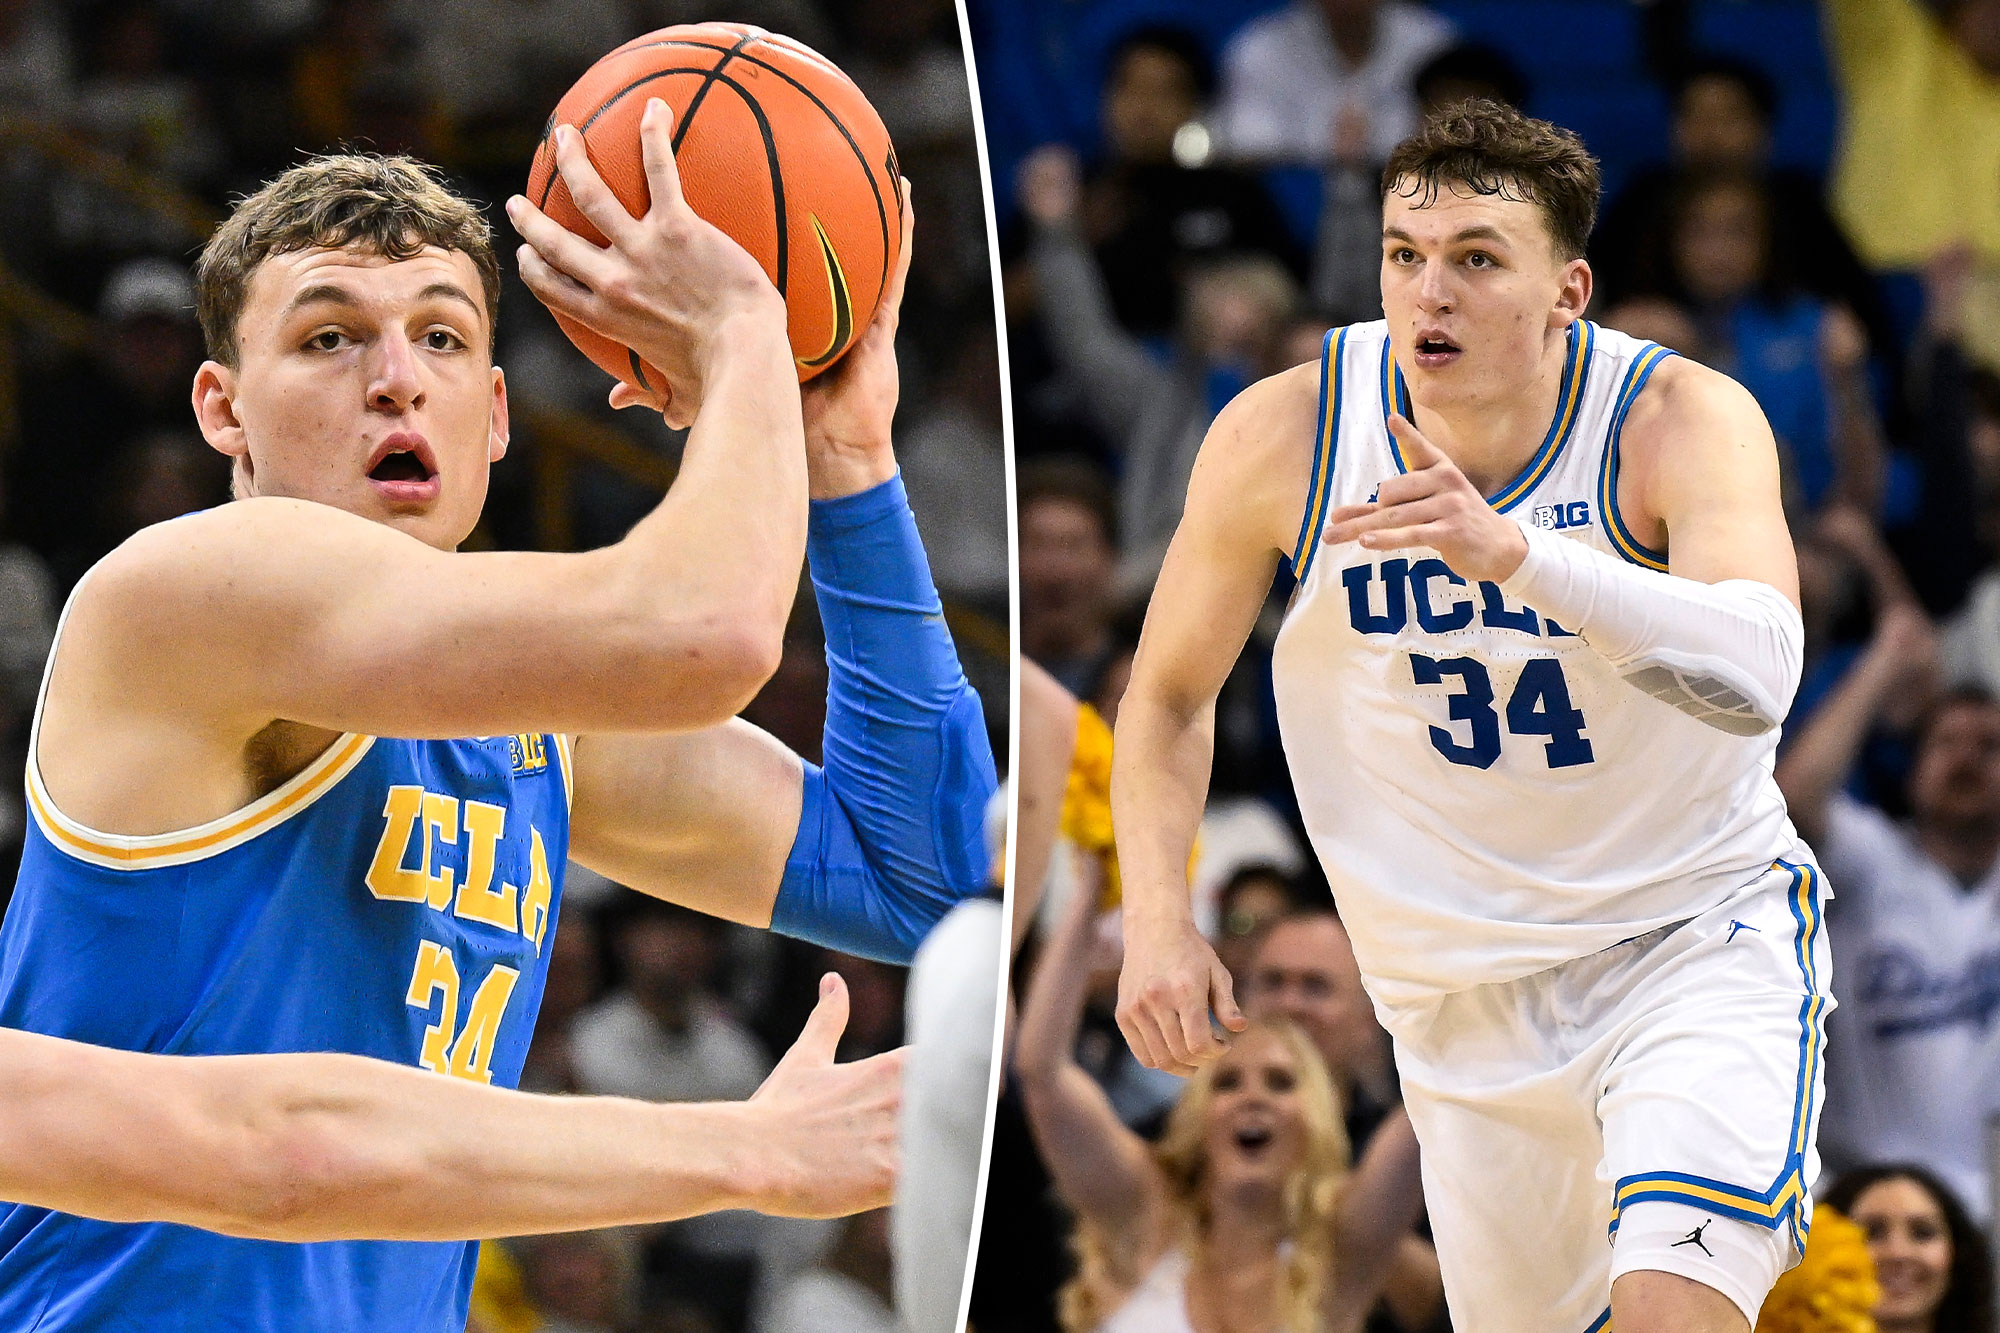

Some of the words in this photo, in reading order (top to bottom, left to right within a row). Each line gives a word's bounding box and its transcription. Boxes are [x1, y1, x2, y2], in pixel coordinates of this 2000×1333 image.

[1342, 558, 1578, 637] UCL
[1409, 653, 1595, 769] 34
[406, 939, 520, 1086] 34
